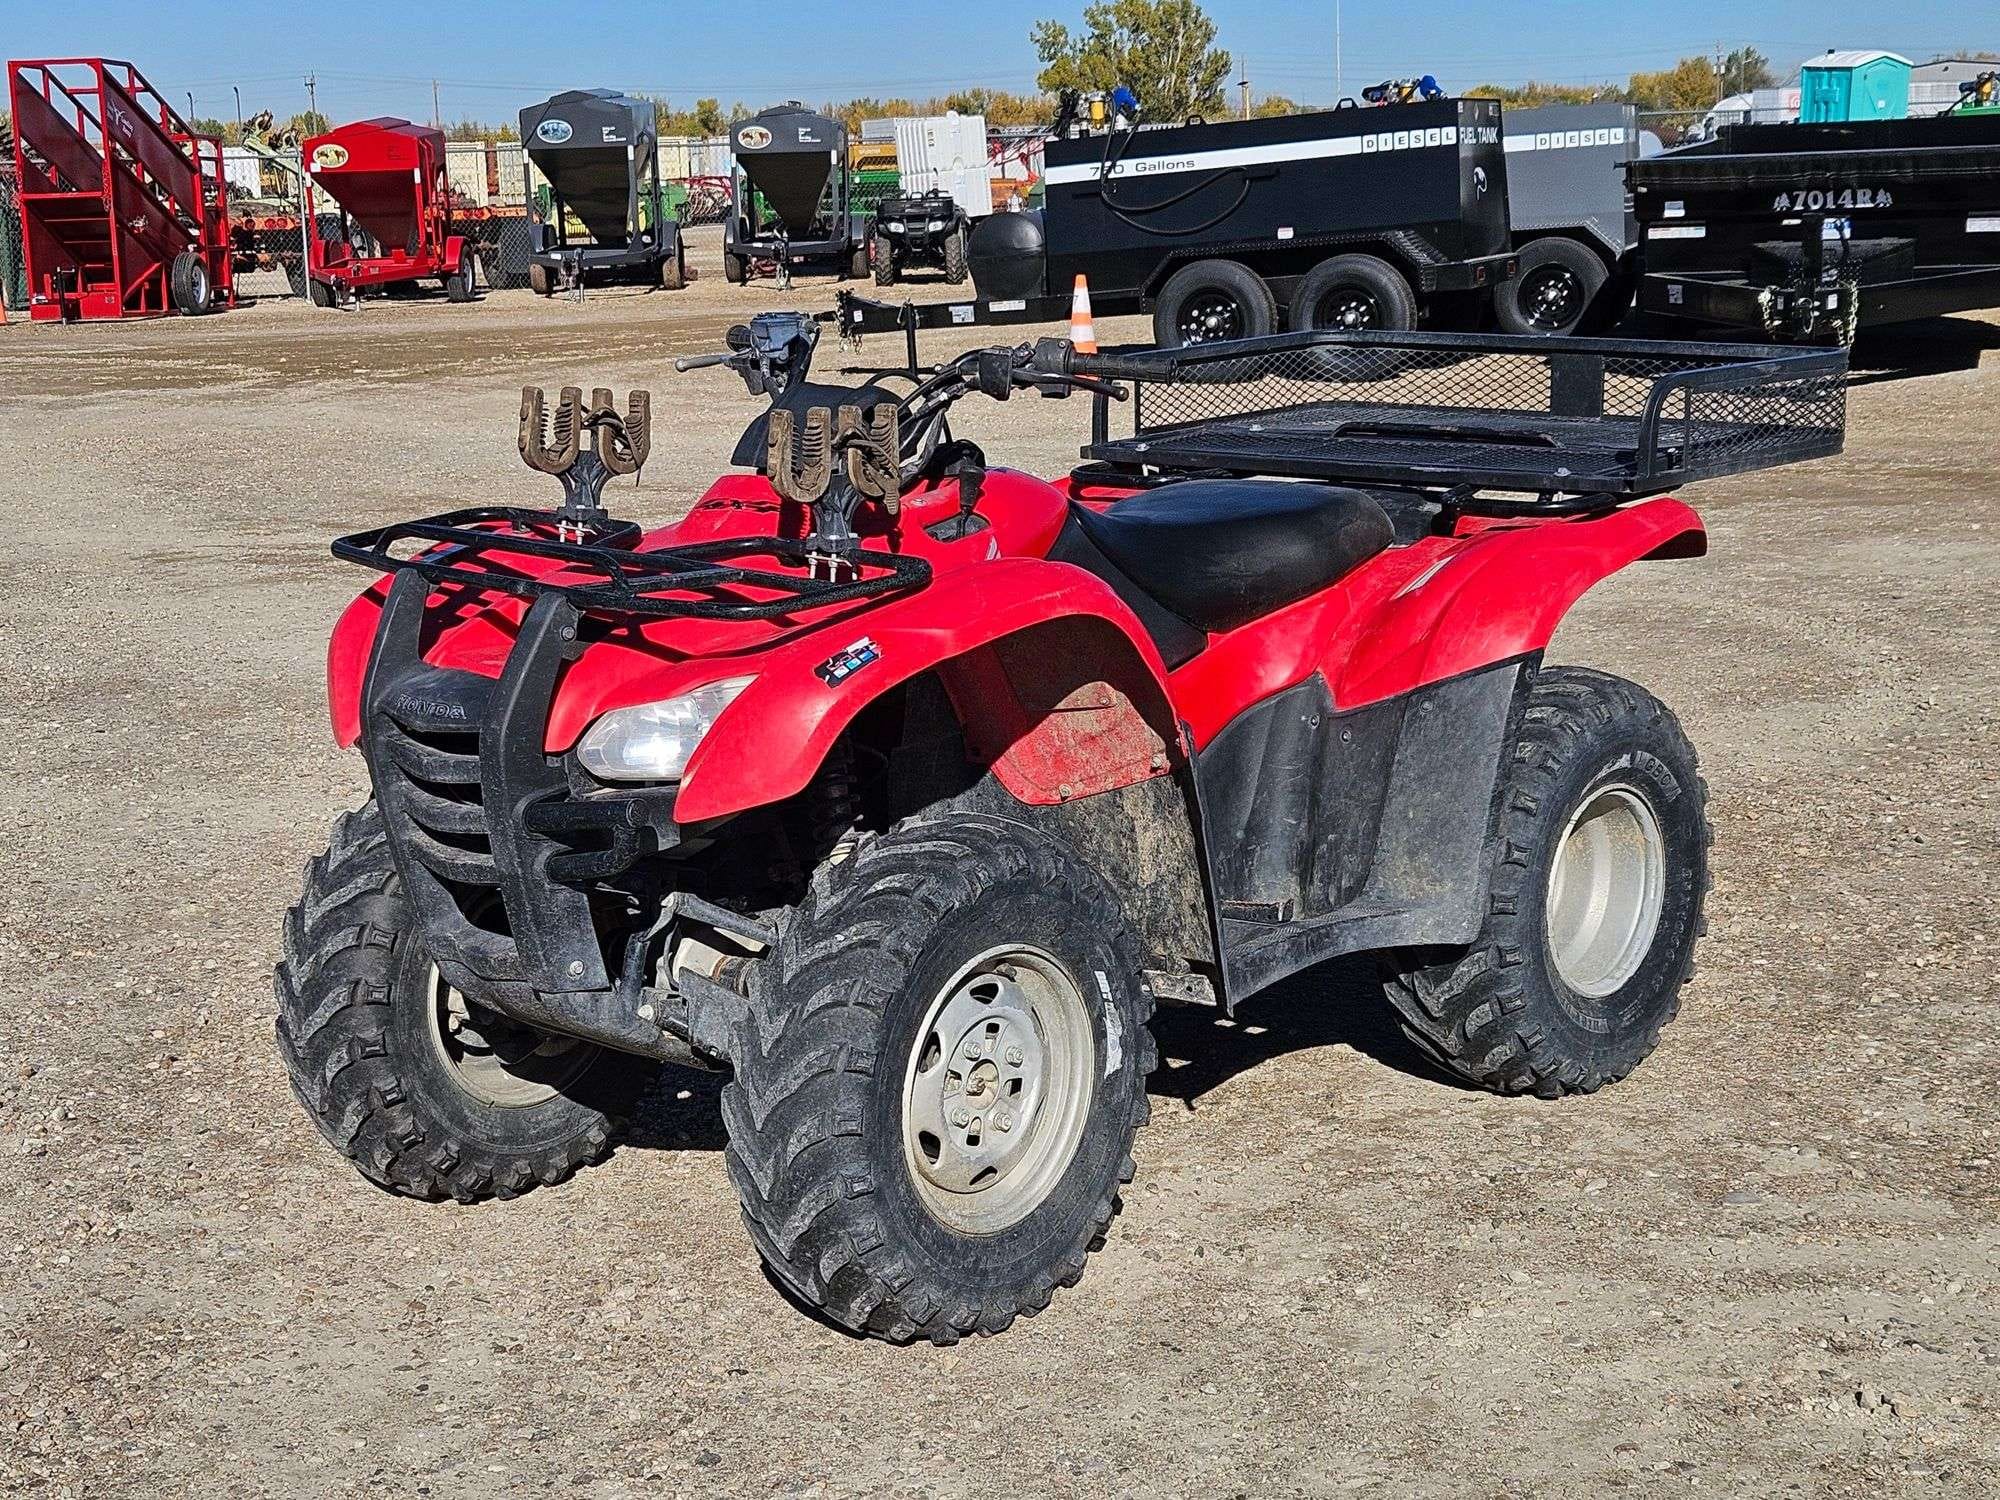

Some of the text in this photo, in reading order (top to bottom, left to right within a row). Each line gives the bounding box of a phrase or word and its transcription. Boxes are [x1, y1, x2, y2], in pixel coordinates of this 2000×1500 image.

[1366, 131, 1453, 148] DIESEL
[1459, 126, 1499, 144] FUEL TANK
[1539, 132, 1621, 146] DIESEL
[1135, 159, 1196, 172] Gallons
[1792, 188, 1875, 211] 7014R
[394, 693, 468, 720] HONDA
